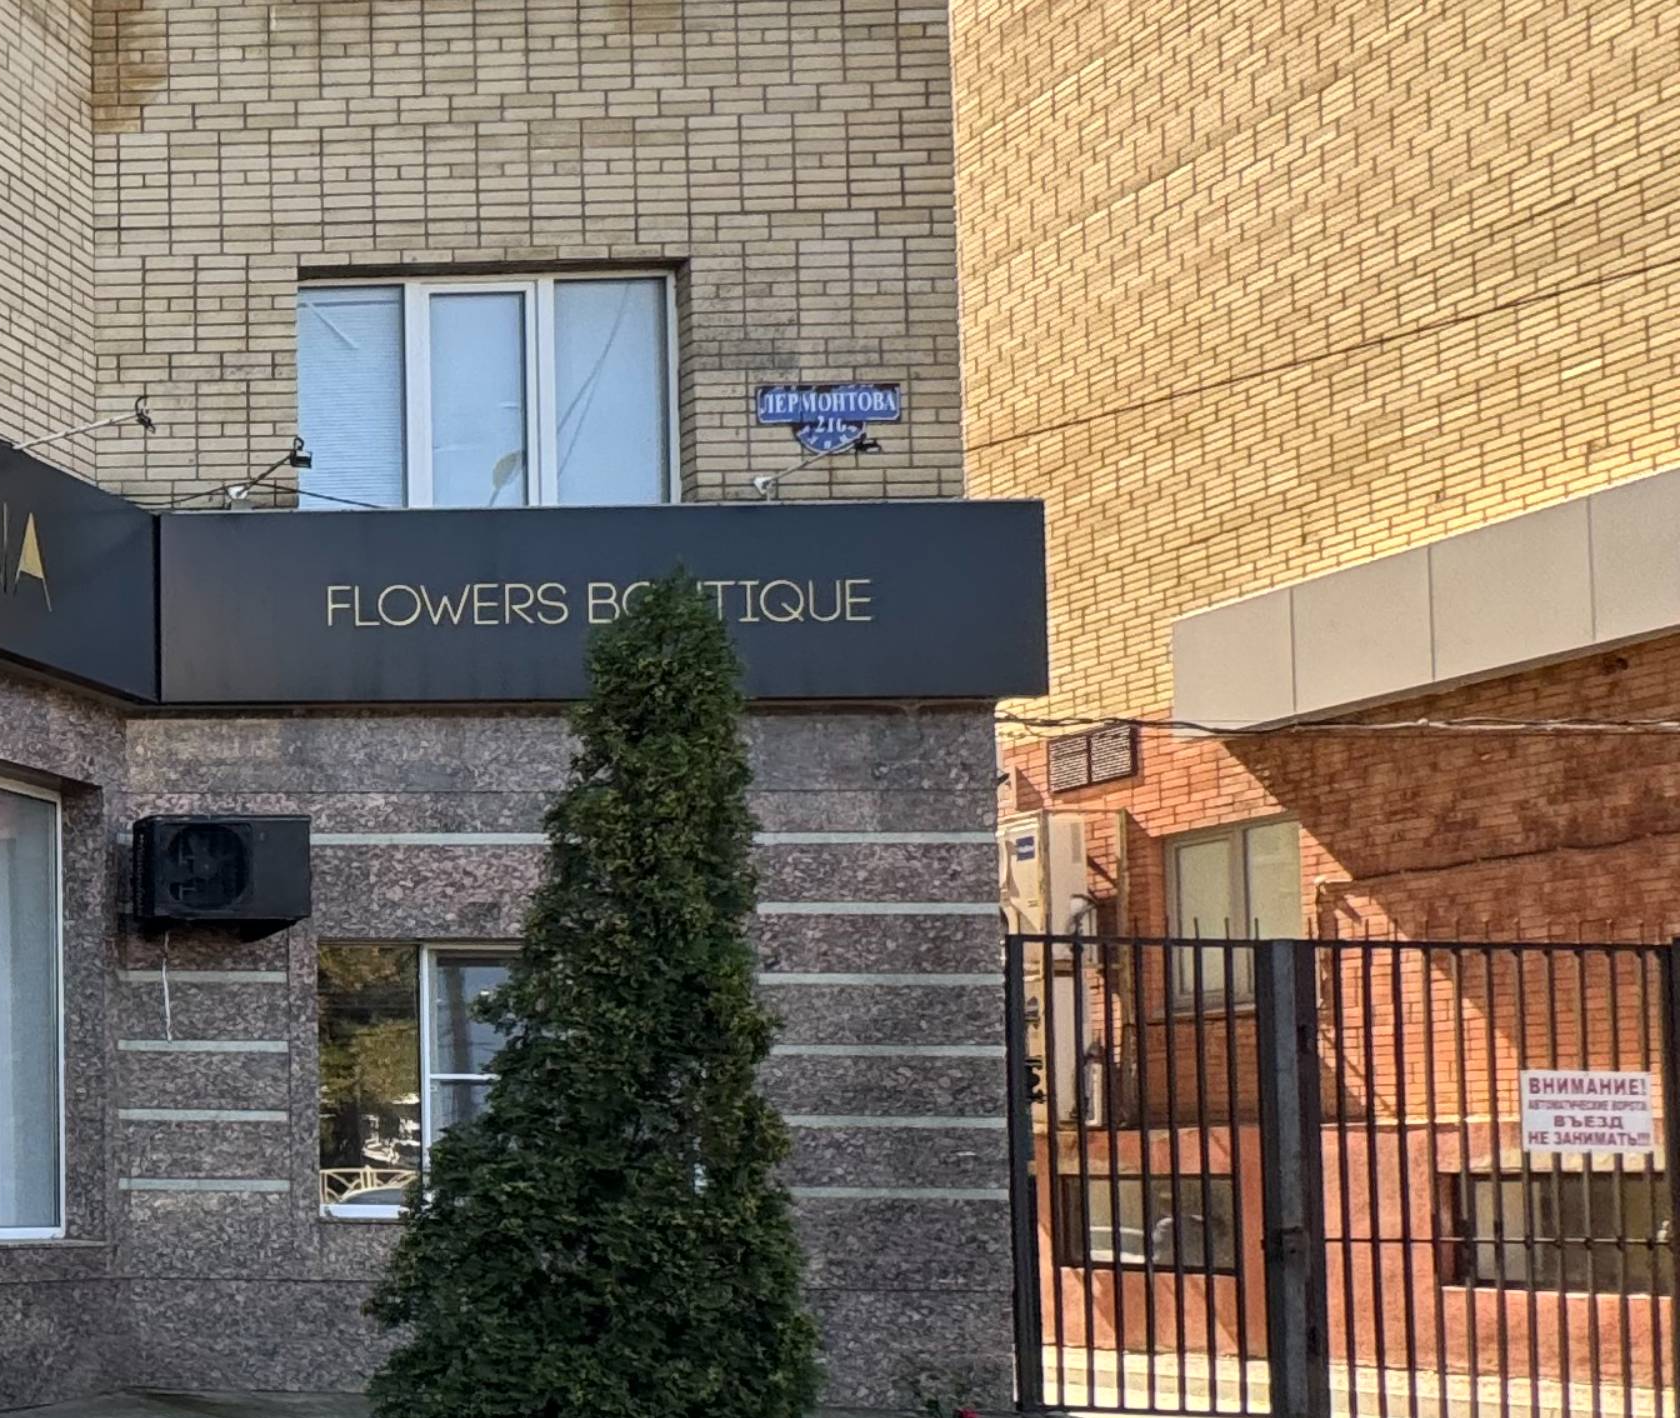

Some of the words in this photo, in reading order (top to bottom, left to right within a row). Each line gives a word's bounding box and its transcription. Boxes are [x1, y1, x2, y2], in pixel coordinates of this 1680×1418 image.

[760, 391, 896, 414] ЛЕРМОНТОВА
[326, 582, 569, 627] FLOWERS
[587, 578, 874, 624] BOTIQUE
[1528, 1077, 1647, 1096] ВНИМАНИЕ!
[1553, 1115, 1624, 1130] ВЪЕЗД
[1528, 1131, 1550, 1145] НЕ
